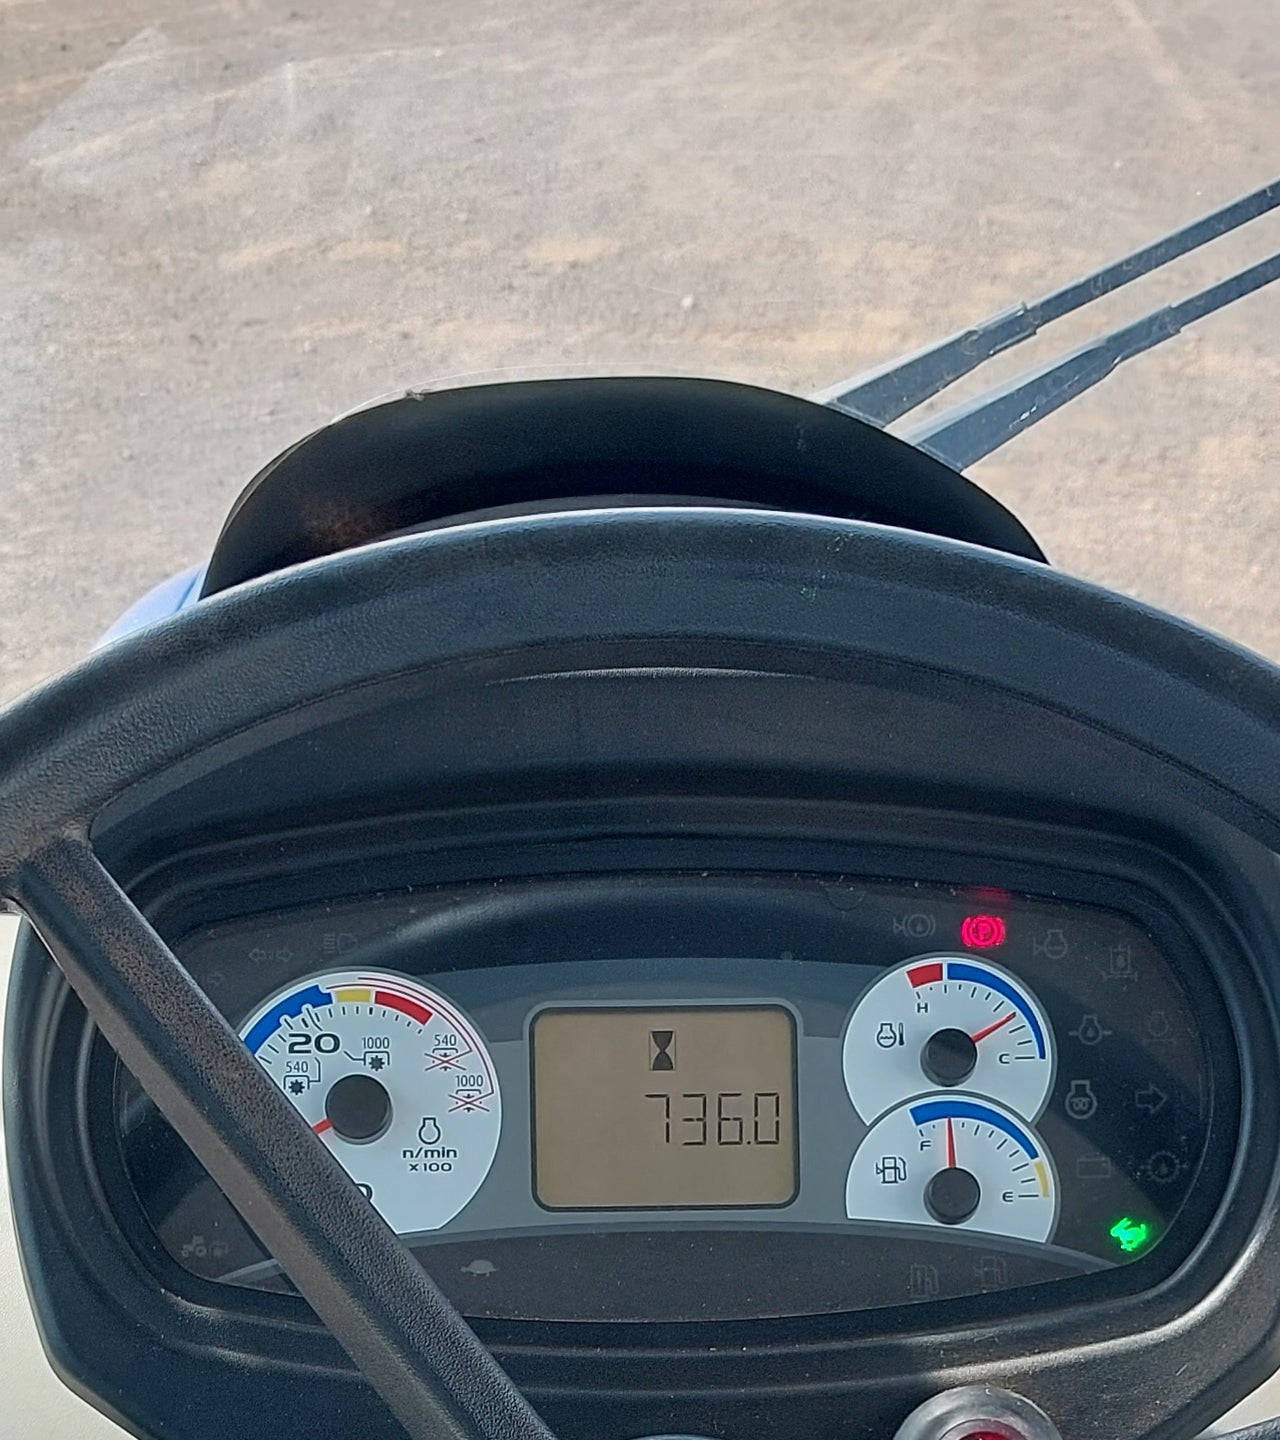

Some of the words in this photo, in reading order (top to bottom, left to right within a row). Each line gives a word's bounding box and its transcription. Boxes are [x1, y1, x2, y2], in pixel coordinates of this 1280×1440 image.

[917, 1003, 929, 1013] H
[288, 1033, 341, 1054] 20
[361, 1036, 390, 1049] 1000
[434, 1034, 457, 1046] 540
[999, 1053, 1010, 1064] C
[285, 1061, 309, 1073] 540
[455, 1075, 484, 1087] 1000
[644, 1093, 780, 1146] 736.0
[920, 1141, 932, 1151] F
[402, 1147, 458, 1159] n/min
[1002, 1192, 1014, 1202] E
